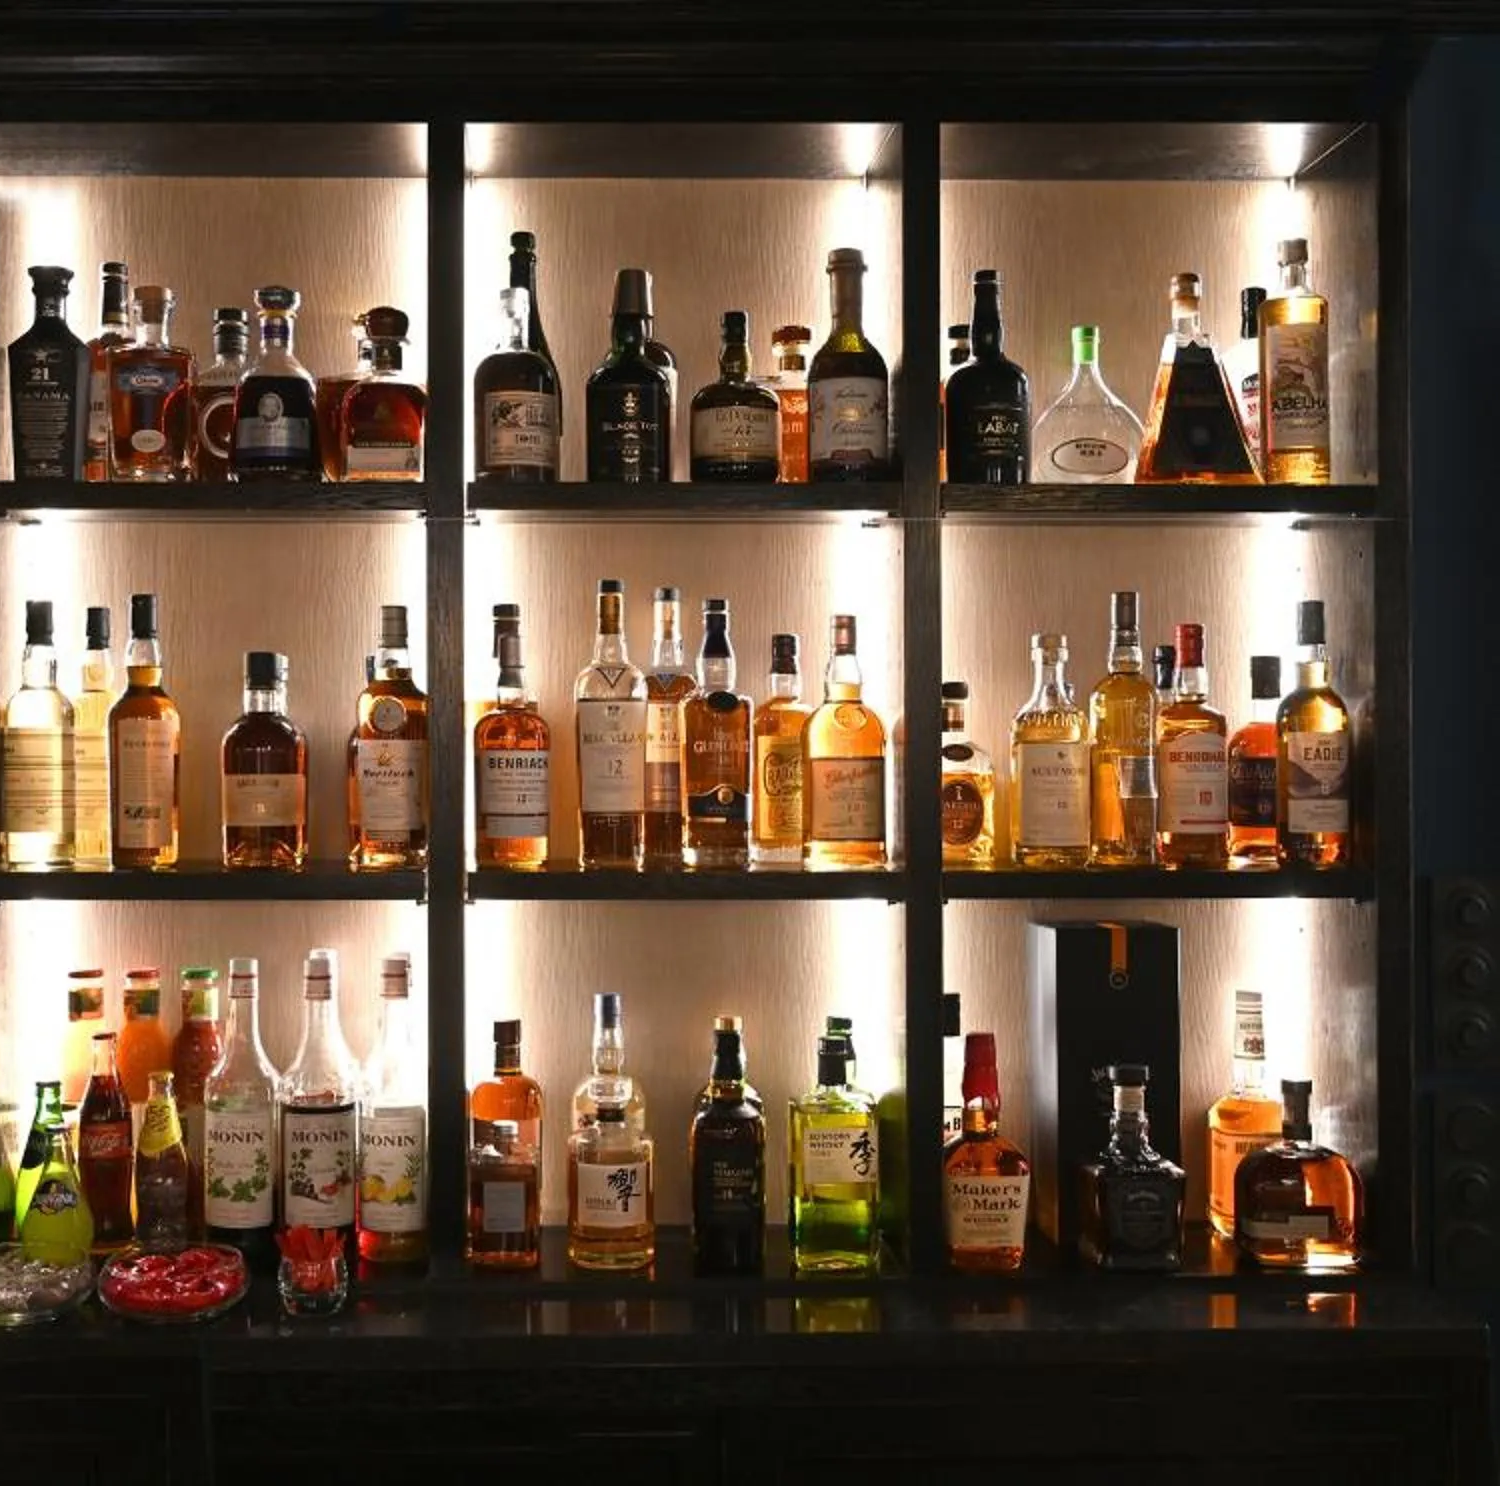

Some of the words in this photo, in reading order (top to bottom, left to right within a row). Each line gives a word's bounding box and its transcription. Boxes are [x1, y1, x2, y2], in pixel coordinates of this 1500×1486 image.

[30, 367, 50, 381] 21
[17, 390, 71, 402] PANAMA
[607, 759, 623, 775] 12
[209, 1130, 264, 1146] MONIN
[291, 1130, 350, 1144] MONIN
[361, 1131, 418, 1147] MONIN
[809, 1142, 844, 1150] WHISKY
[952, 1183, 1022, 1197] Maker's
[973, 1199, 1022, 1212] Mark
